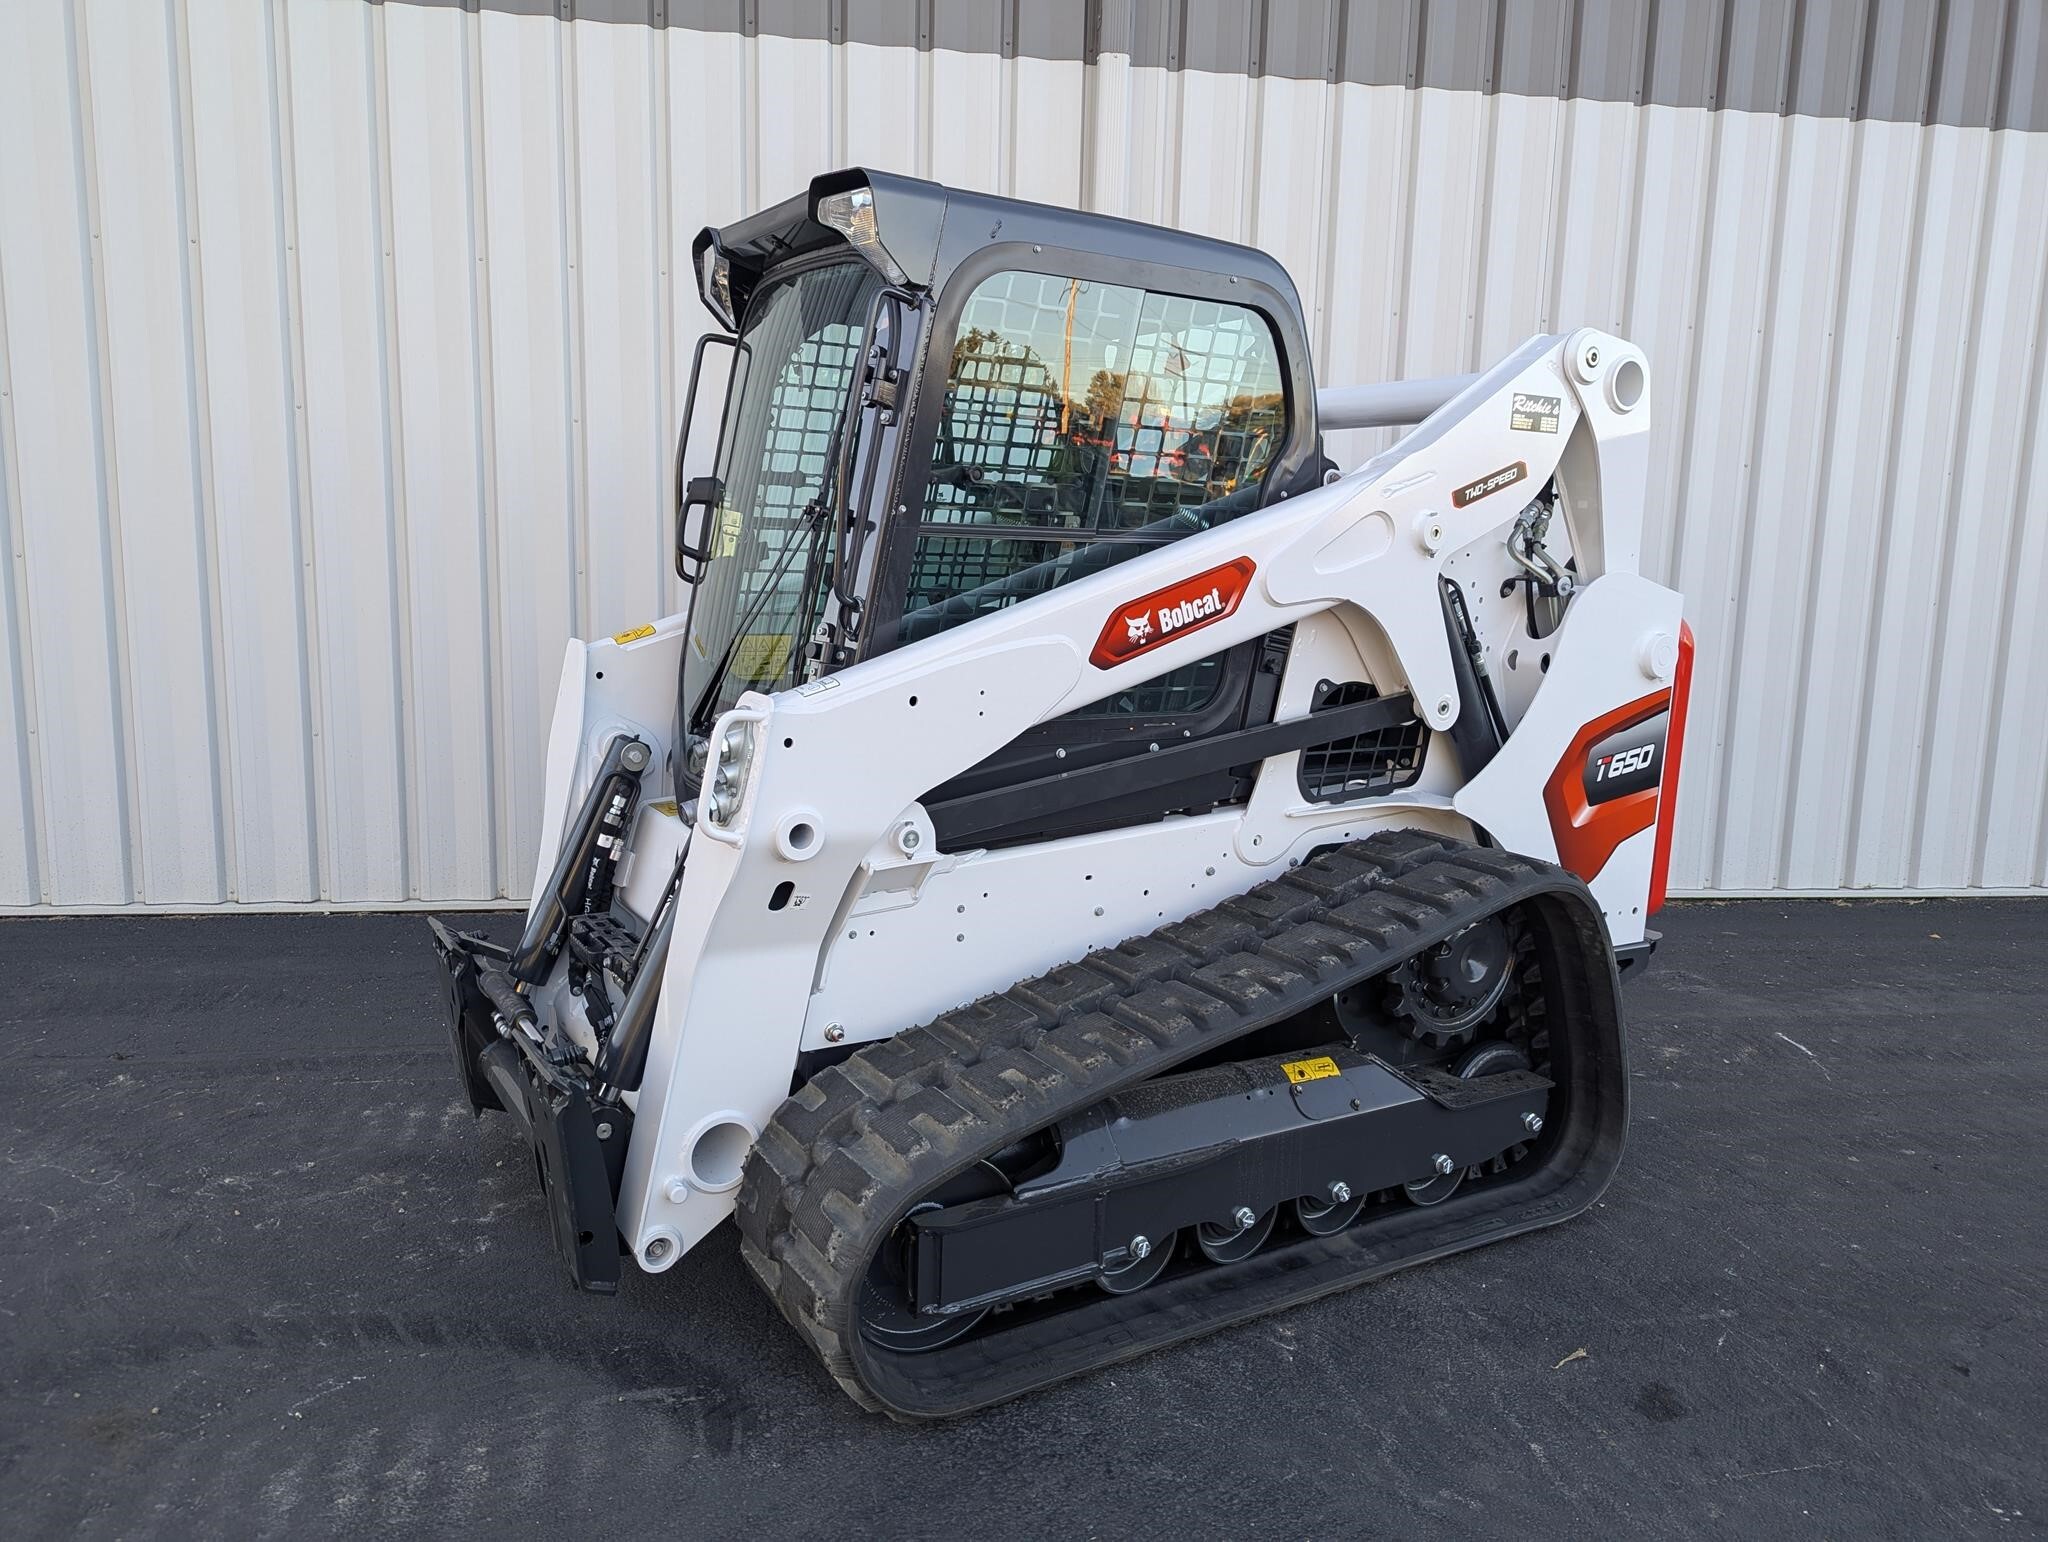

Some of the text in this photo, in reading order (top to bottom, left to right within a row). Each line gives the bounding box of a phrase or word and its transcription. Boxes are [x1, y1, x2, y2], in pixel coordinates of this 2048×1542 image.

[1513, 395, 1560, 415] Ritchie's
[1465, 468, 1517, 500] TWO-SPEED
[1158, 588, 1223, 634] Bobcat
[1596, 744, 1655, 782] T650
